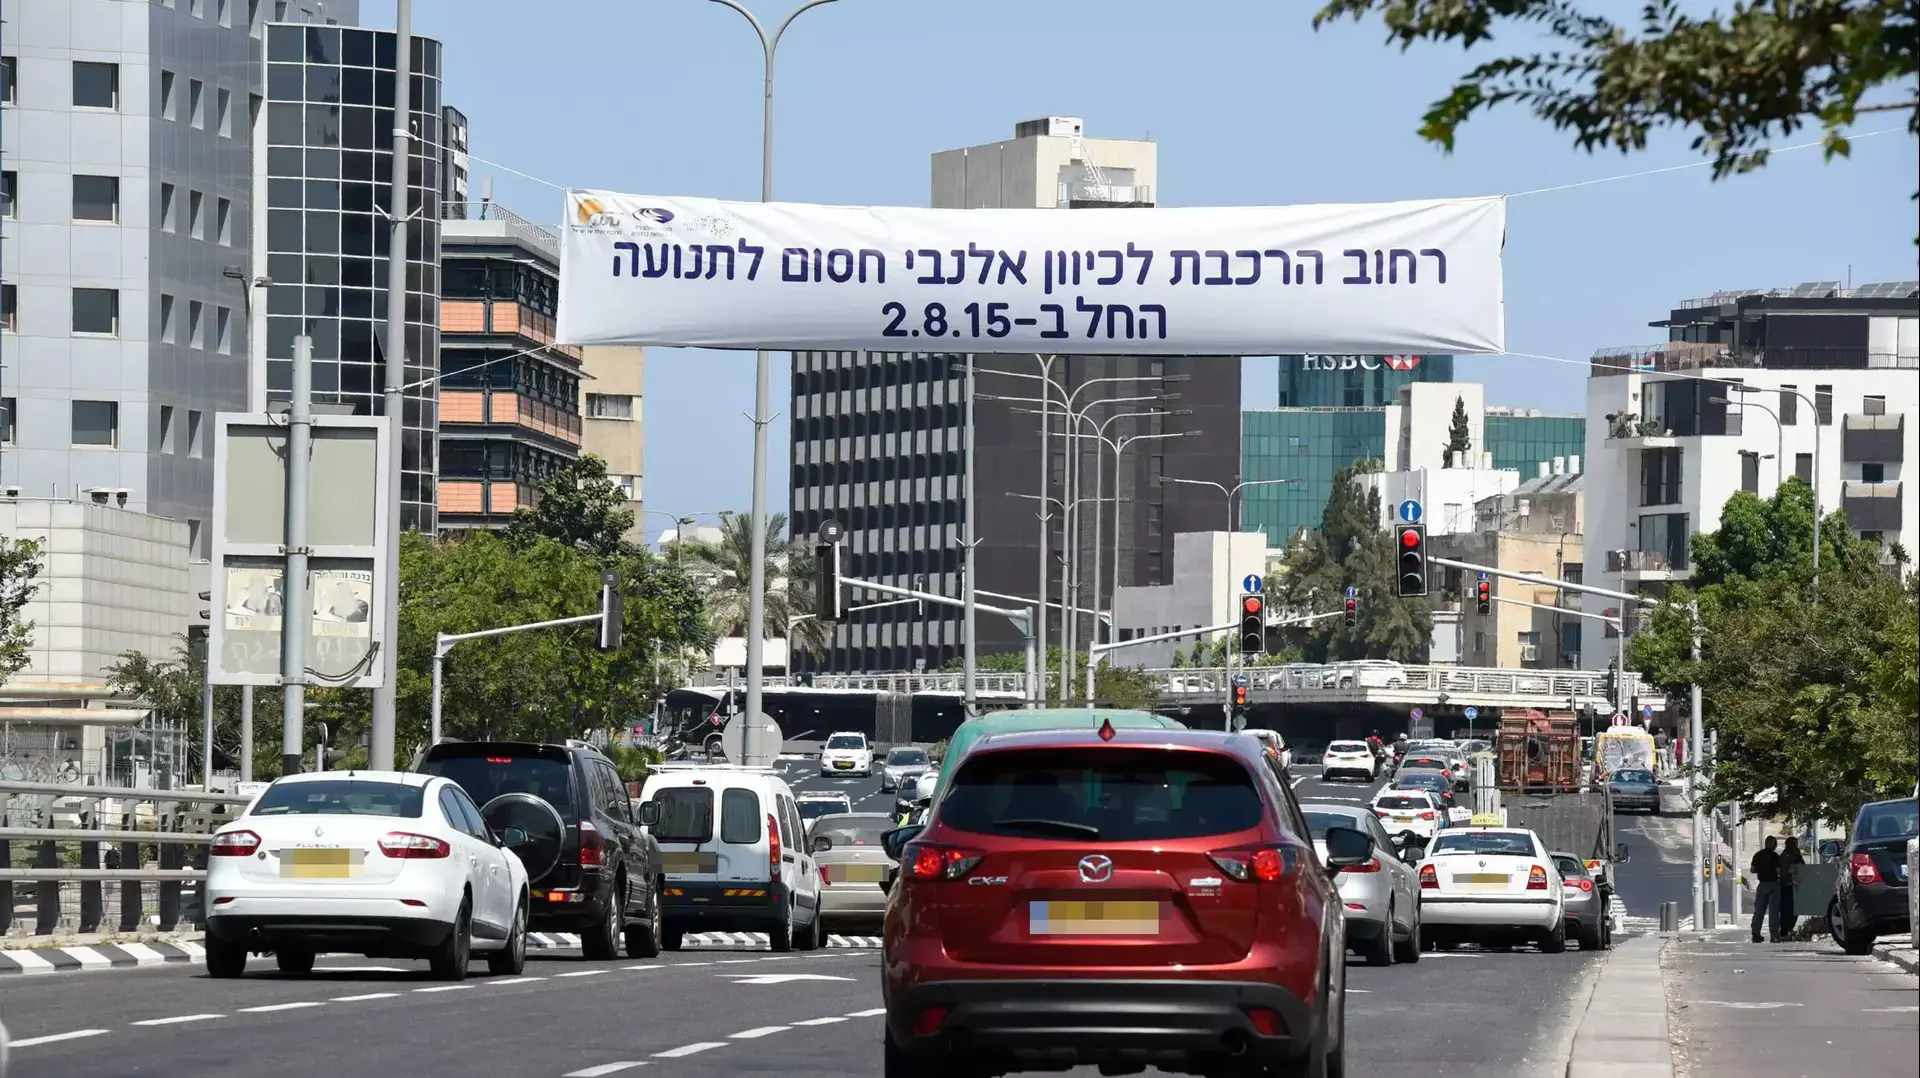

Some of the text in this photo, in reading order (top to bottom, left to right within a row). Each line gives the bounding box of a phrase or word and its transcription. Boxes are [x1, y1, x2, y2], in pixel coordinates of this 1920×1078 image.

[612, 237, 1446, 294] רחוב הרכבת לכיוון אלנבי חסום לתנועה
[1302, 354, 1380, 370] HSBC
